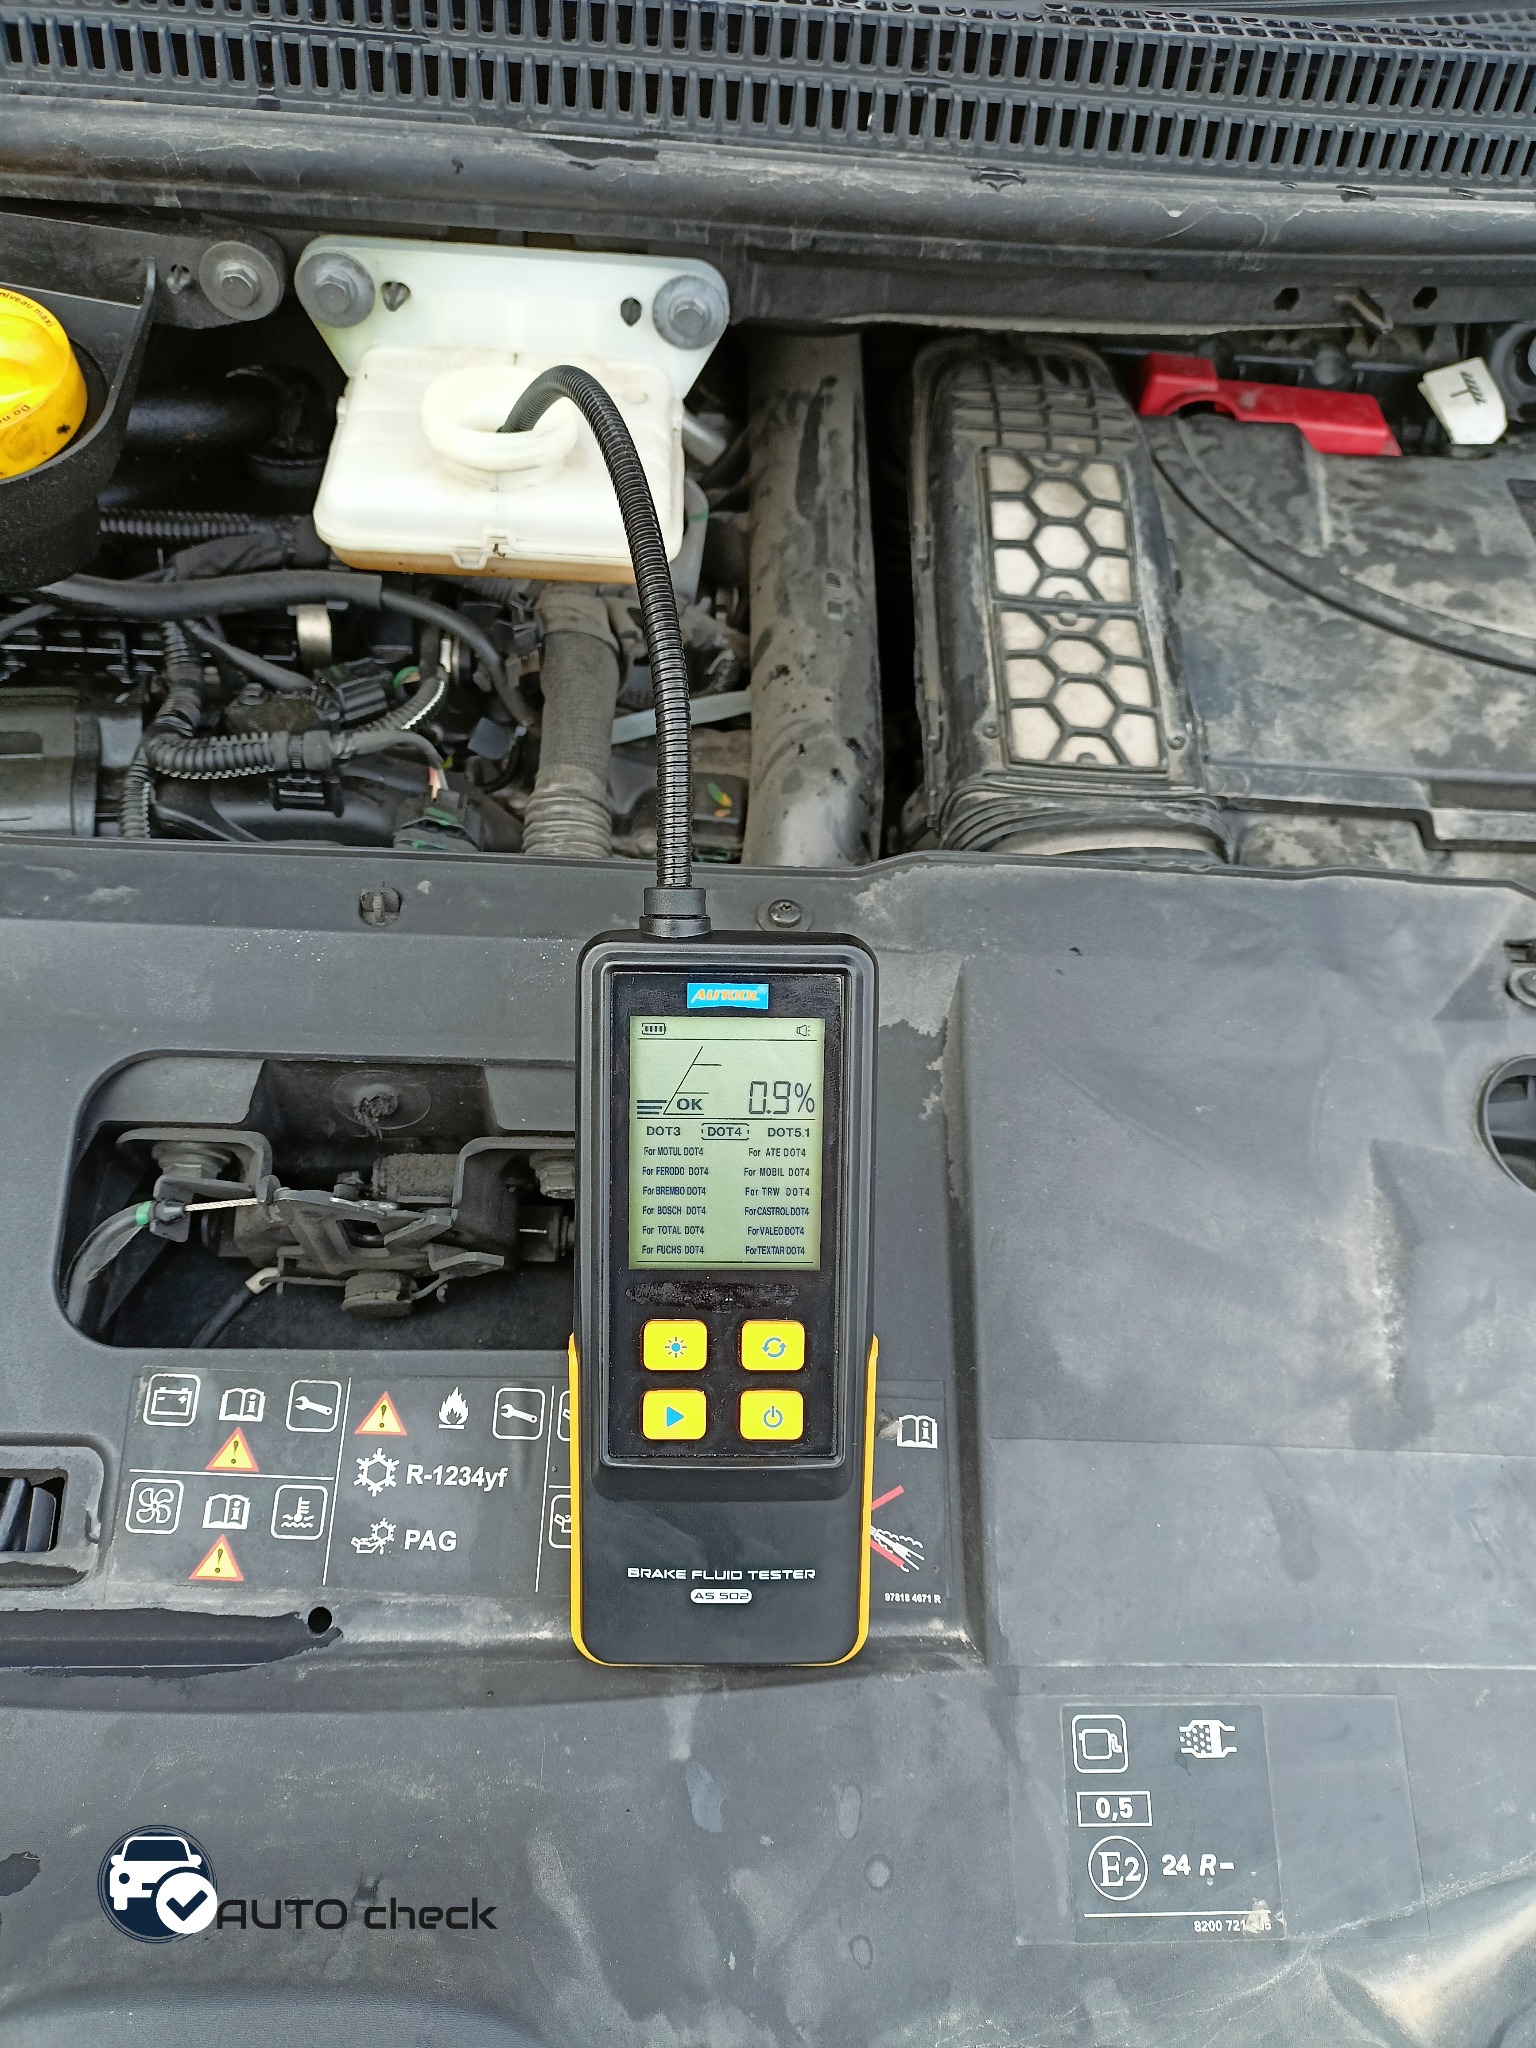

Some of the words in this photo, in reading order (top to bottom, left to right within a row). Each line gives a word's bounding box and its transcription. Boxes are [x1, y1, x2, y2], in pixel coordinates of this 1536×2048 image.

[0, 292, 33, 309] niveau
[34, 308, 53, 327] maxi
[690, 988, 760, 1004] AUTOOL
[676, 1098, 703, 1111] OK
[749, 1081, 815, 1115] 0.9%
[646, 1126, 681, 1136] DOT3
[707, 1126, 742, 1137] DOT4
[767, 1127, 810, 1138] DOT5.1
[644, 1147, 655, 1156] For
[657, 1147, 682, 1156] MOTUL
[683, 1147, 704, 1156] DOT4
[748, 1148, 761, 1157] For
[765, 1148, 781, 1157] ATE
[783, 1148, 806, 1157] DOT4
[642, 1166, 654, 1176] For
[656, 1166, 685, 1176] FERODO
[688, 1166, 709, 1176] DOT4
[743, 1167, 756, 1177] For
[759, 1167, 784, 1177] MOBIL
[788, 1167, 810, 1177] DOT4
[642, 1186, 654, 1196] For
[656, 1186, 685, 1196] BREMBO
[687, 1186, 706, 1196] DOT4
[745, 1187, 758, 1197] For
[762, 1187, 780, 1197] TRW
[786, 1187, 810, 1197] DOT4
[642, 1206, 654, 1215] For
[657, 1206, 682, 1215] BOSCH
[686, 1206, 706, 1215] DOT4
[790, 1206, 809, 1216] DOT4
[642, 1225, 654, 1235] For
[657, 1225, 682, 1235] TOTAL
[684, 1225, 704, 1235] DOT4
[785, 1226, 804, 1236] DOT4
[642, 1245, 653, 1255] For
[656, 1245, 682, 1255] FUCHS
[684, 1245, 704, 1255] DOT4
[786, 1246, 805, 1255] DOT4
[406, 1463, 508, 1491] R-1234yf
[404, 1529, 457, 1551] PAG
[627, 1567, 686, 1579] BRAKE
[692, 1570, 743, 1580] FLUID
[748, 1569, 816, 1580] TESTER
[694, 1592, 714, 1600] AS
[719, 1592, 749, 1600] 502
[934, 1594, 941, 1604] R
[1095, 1797, 1133, 1822] 0,5
[1098, 1851, 1142, 1887] E2
[1161, 1854, 1191, 1876] 24
[1193, 1920, 1223, 1932] 8200
